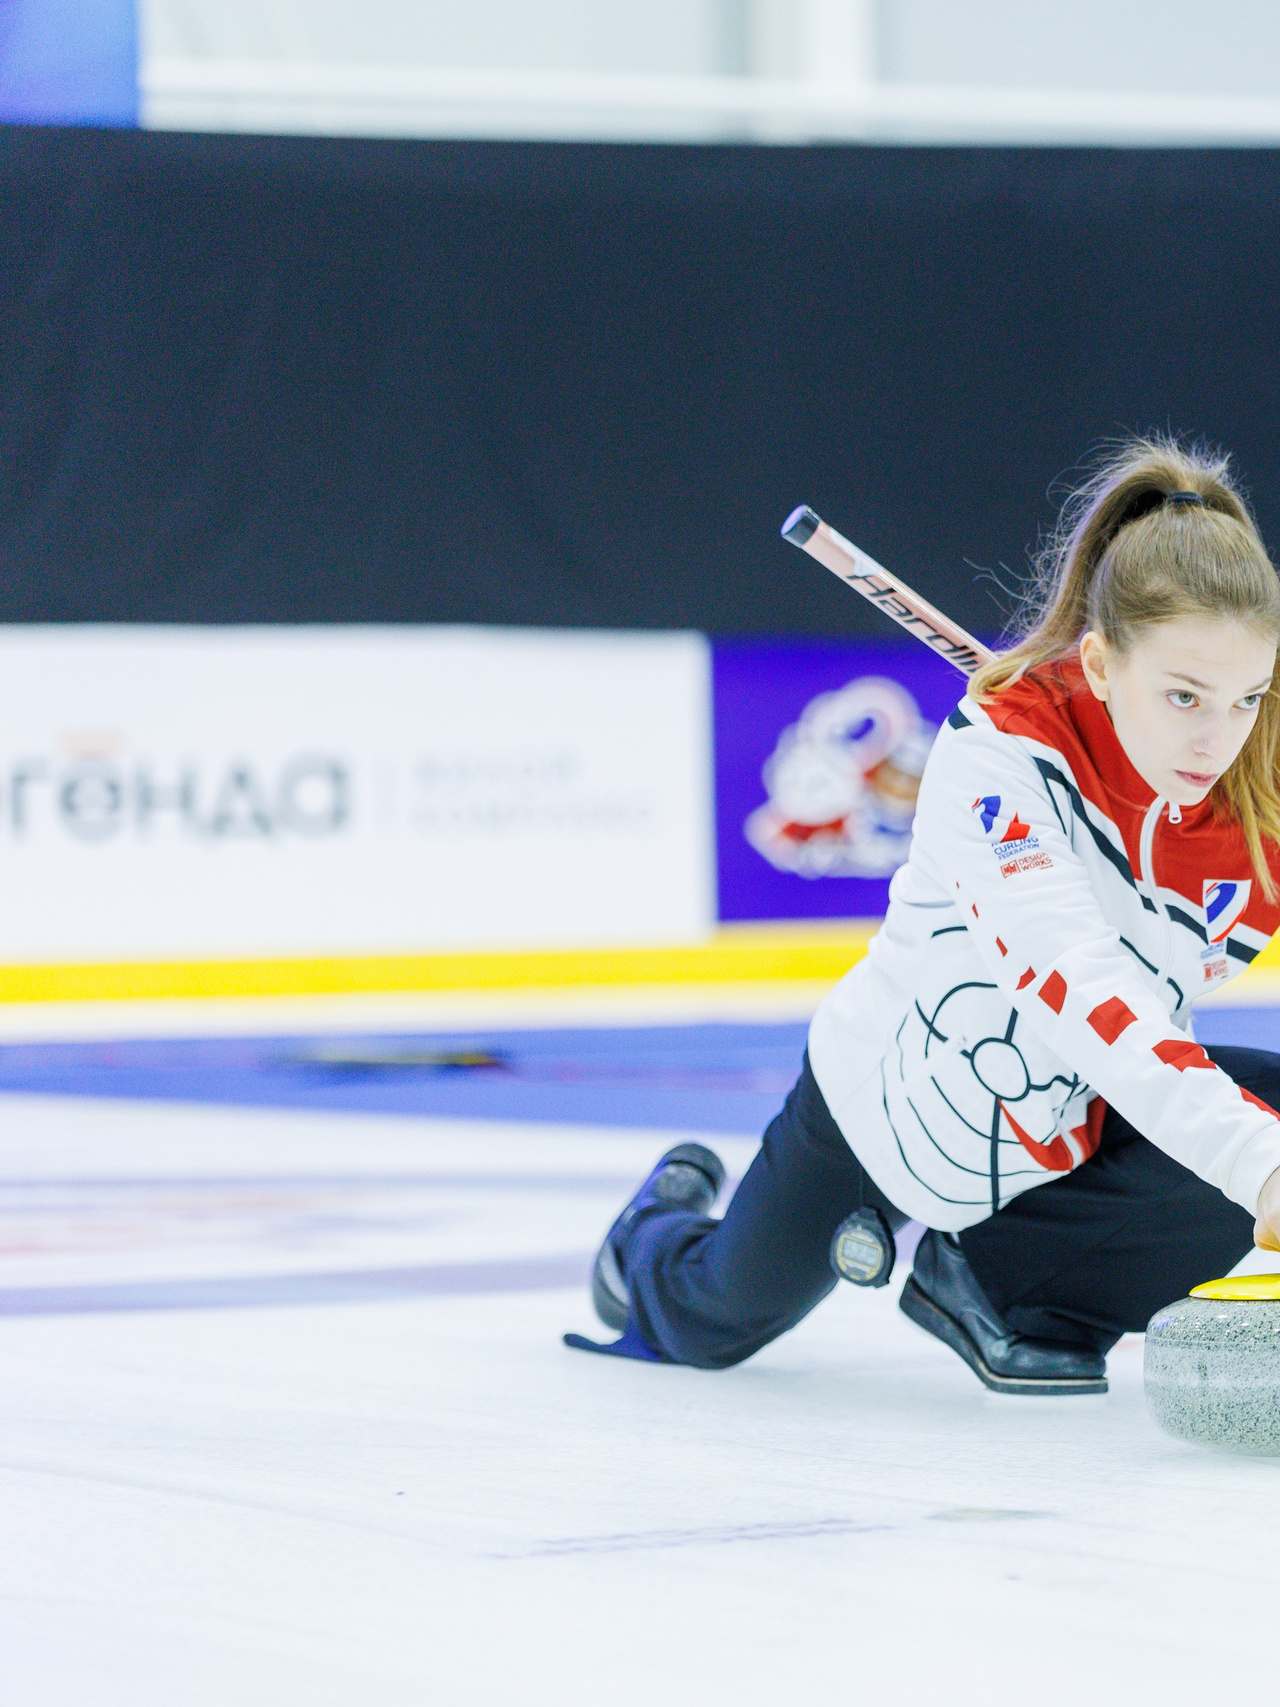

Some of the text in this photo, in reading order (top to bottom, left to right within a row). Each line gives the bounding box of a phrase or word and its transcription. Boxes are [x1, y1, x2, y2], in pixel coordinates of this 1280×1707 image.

[846, 573, 982, 673] Hardli
[994, 836, 1039, 855] CURLING
[1020, 856, 1053, 871] WORKS
